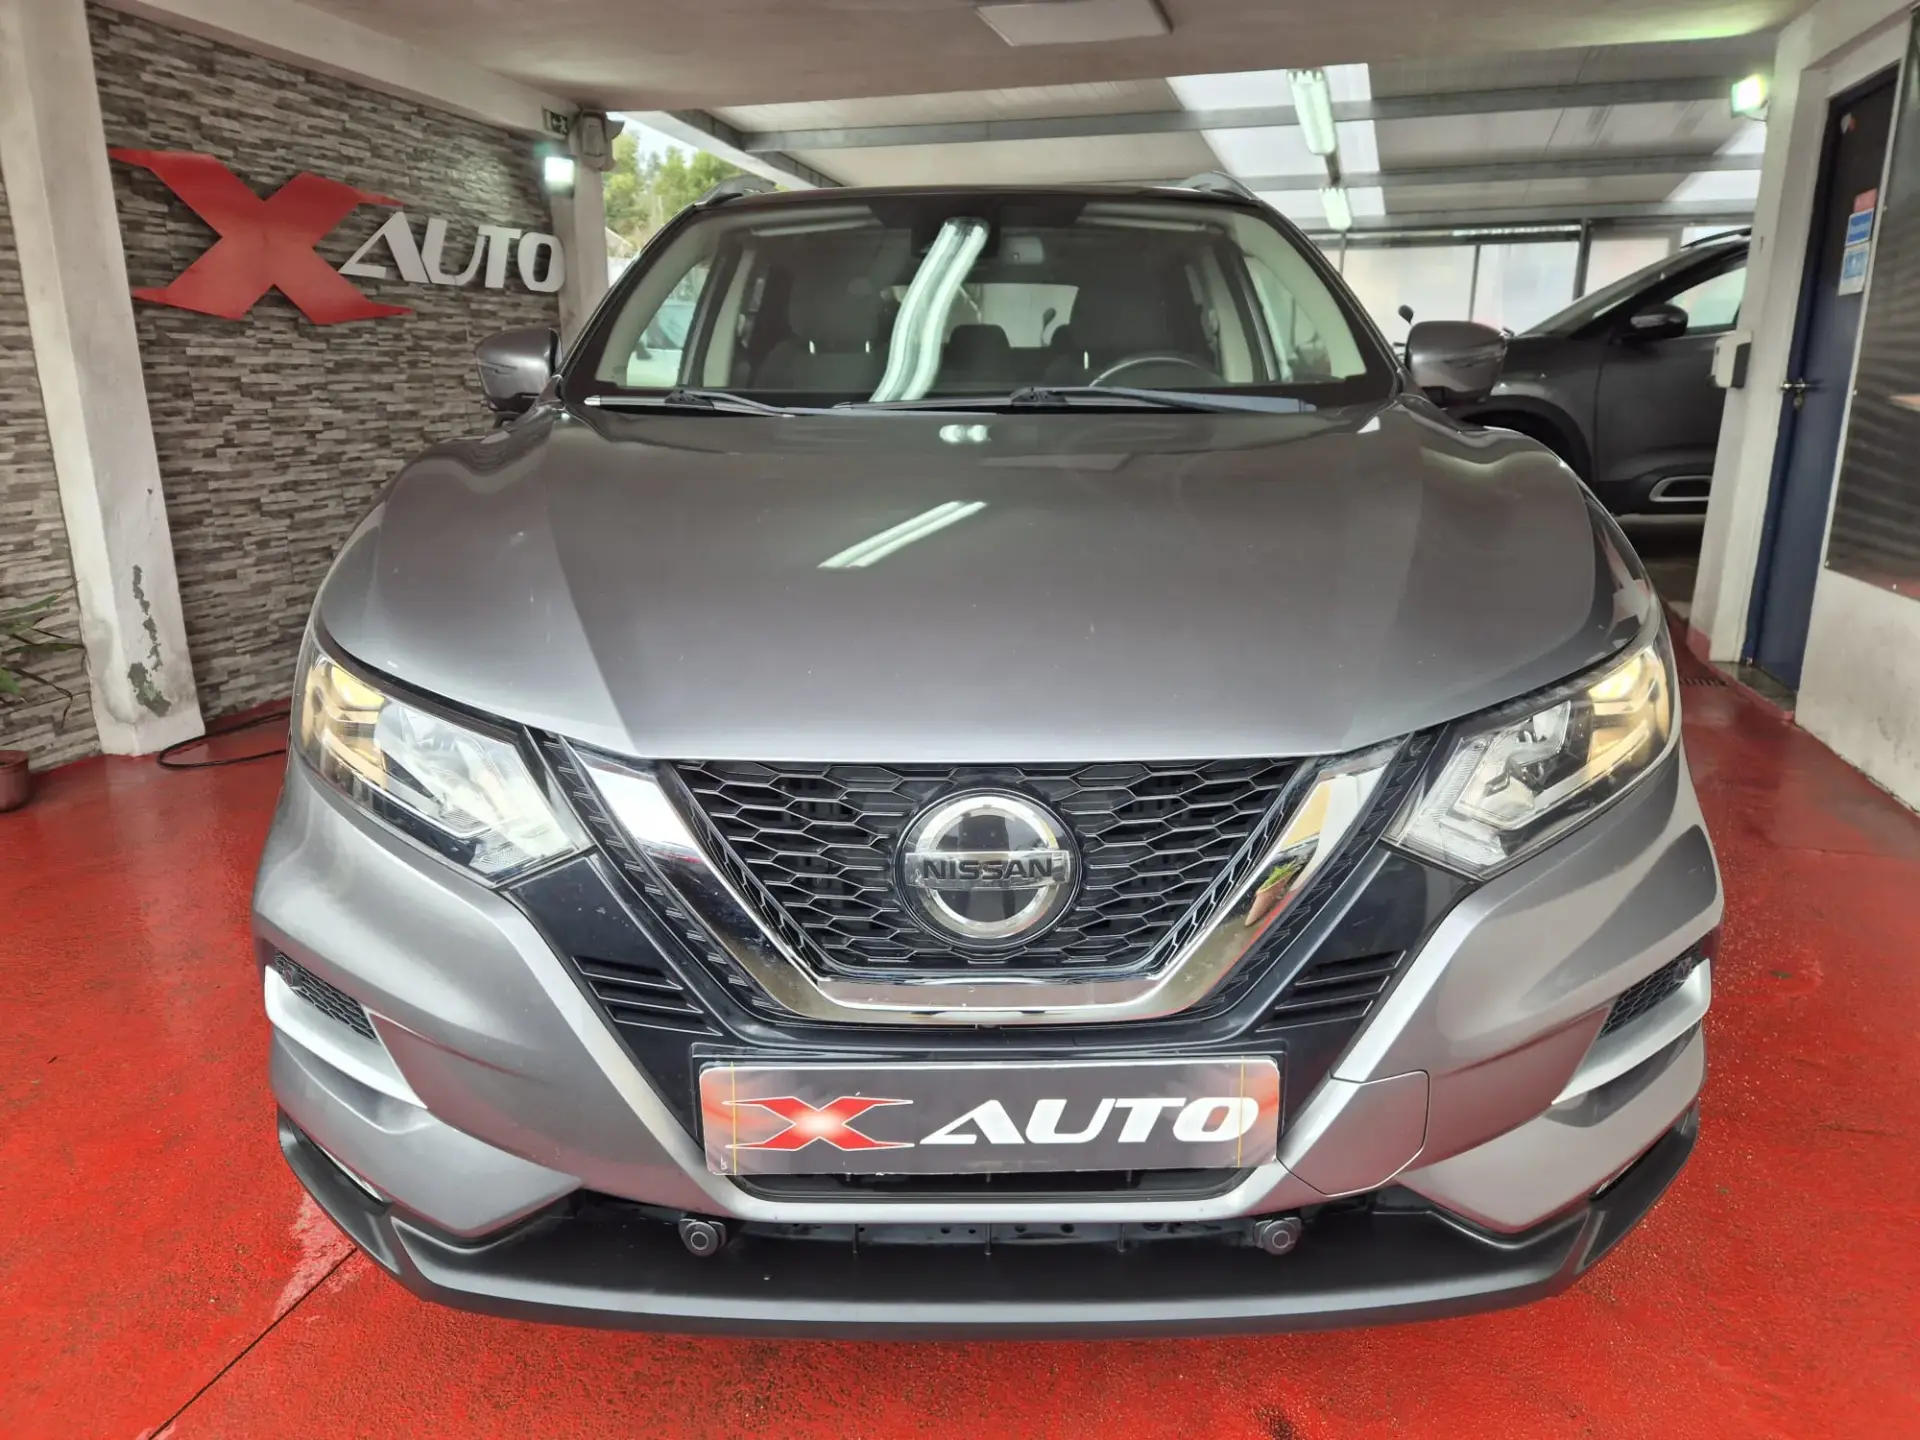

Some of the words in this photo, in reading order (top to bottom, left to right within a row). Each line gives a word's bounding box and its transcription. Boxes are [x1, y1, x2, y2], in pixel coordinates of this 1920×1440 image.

[108, 148, 413, 325] X
[338, 211, 565, 293] AUTO
[923, 858, 1053, 881] NISSAN
[919, 1097, 1260, 1146] AUTO
